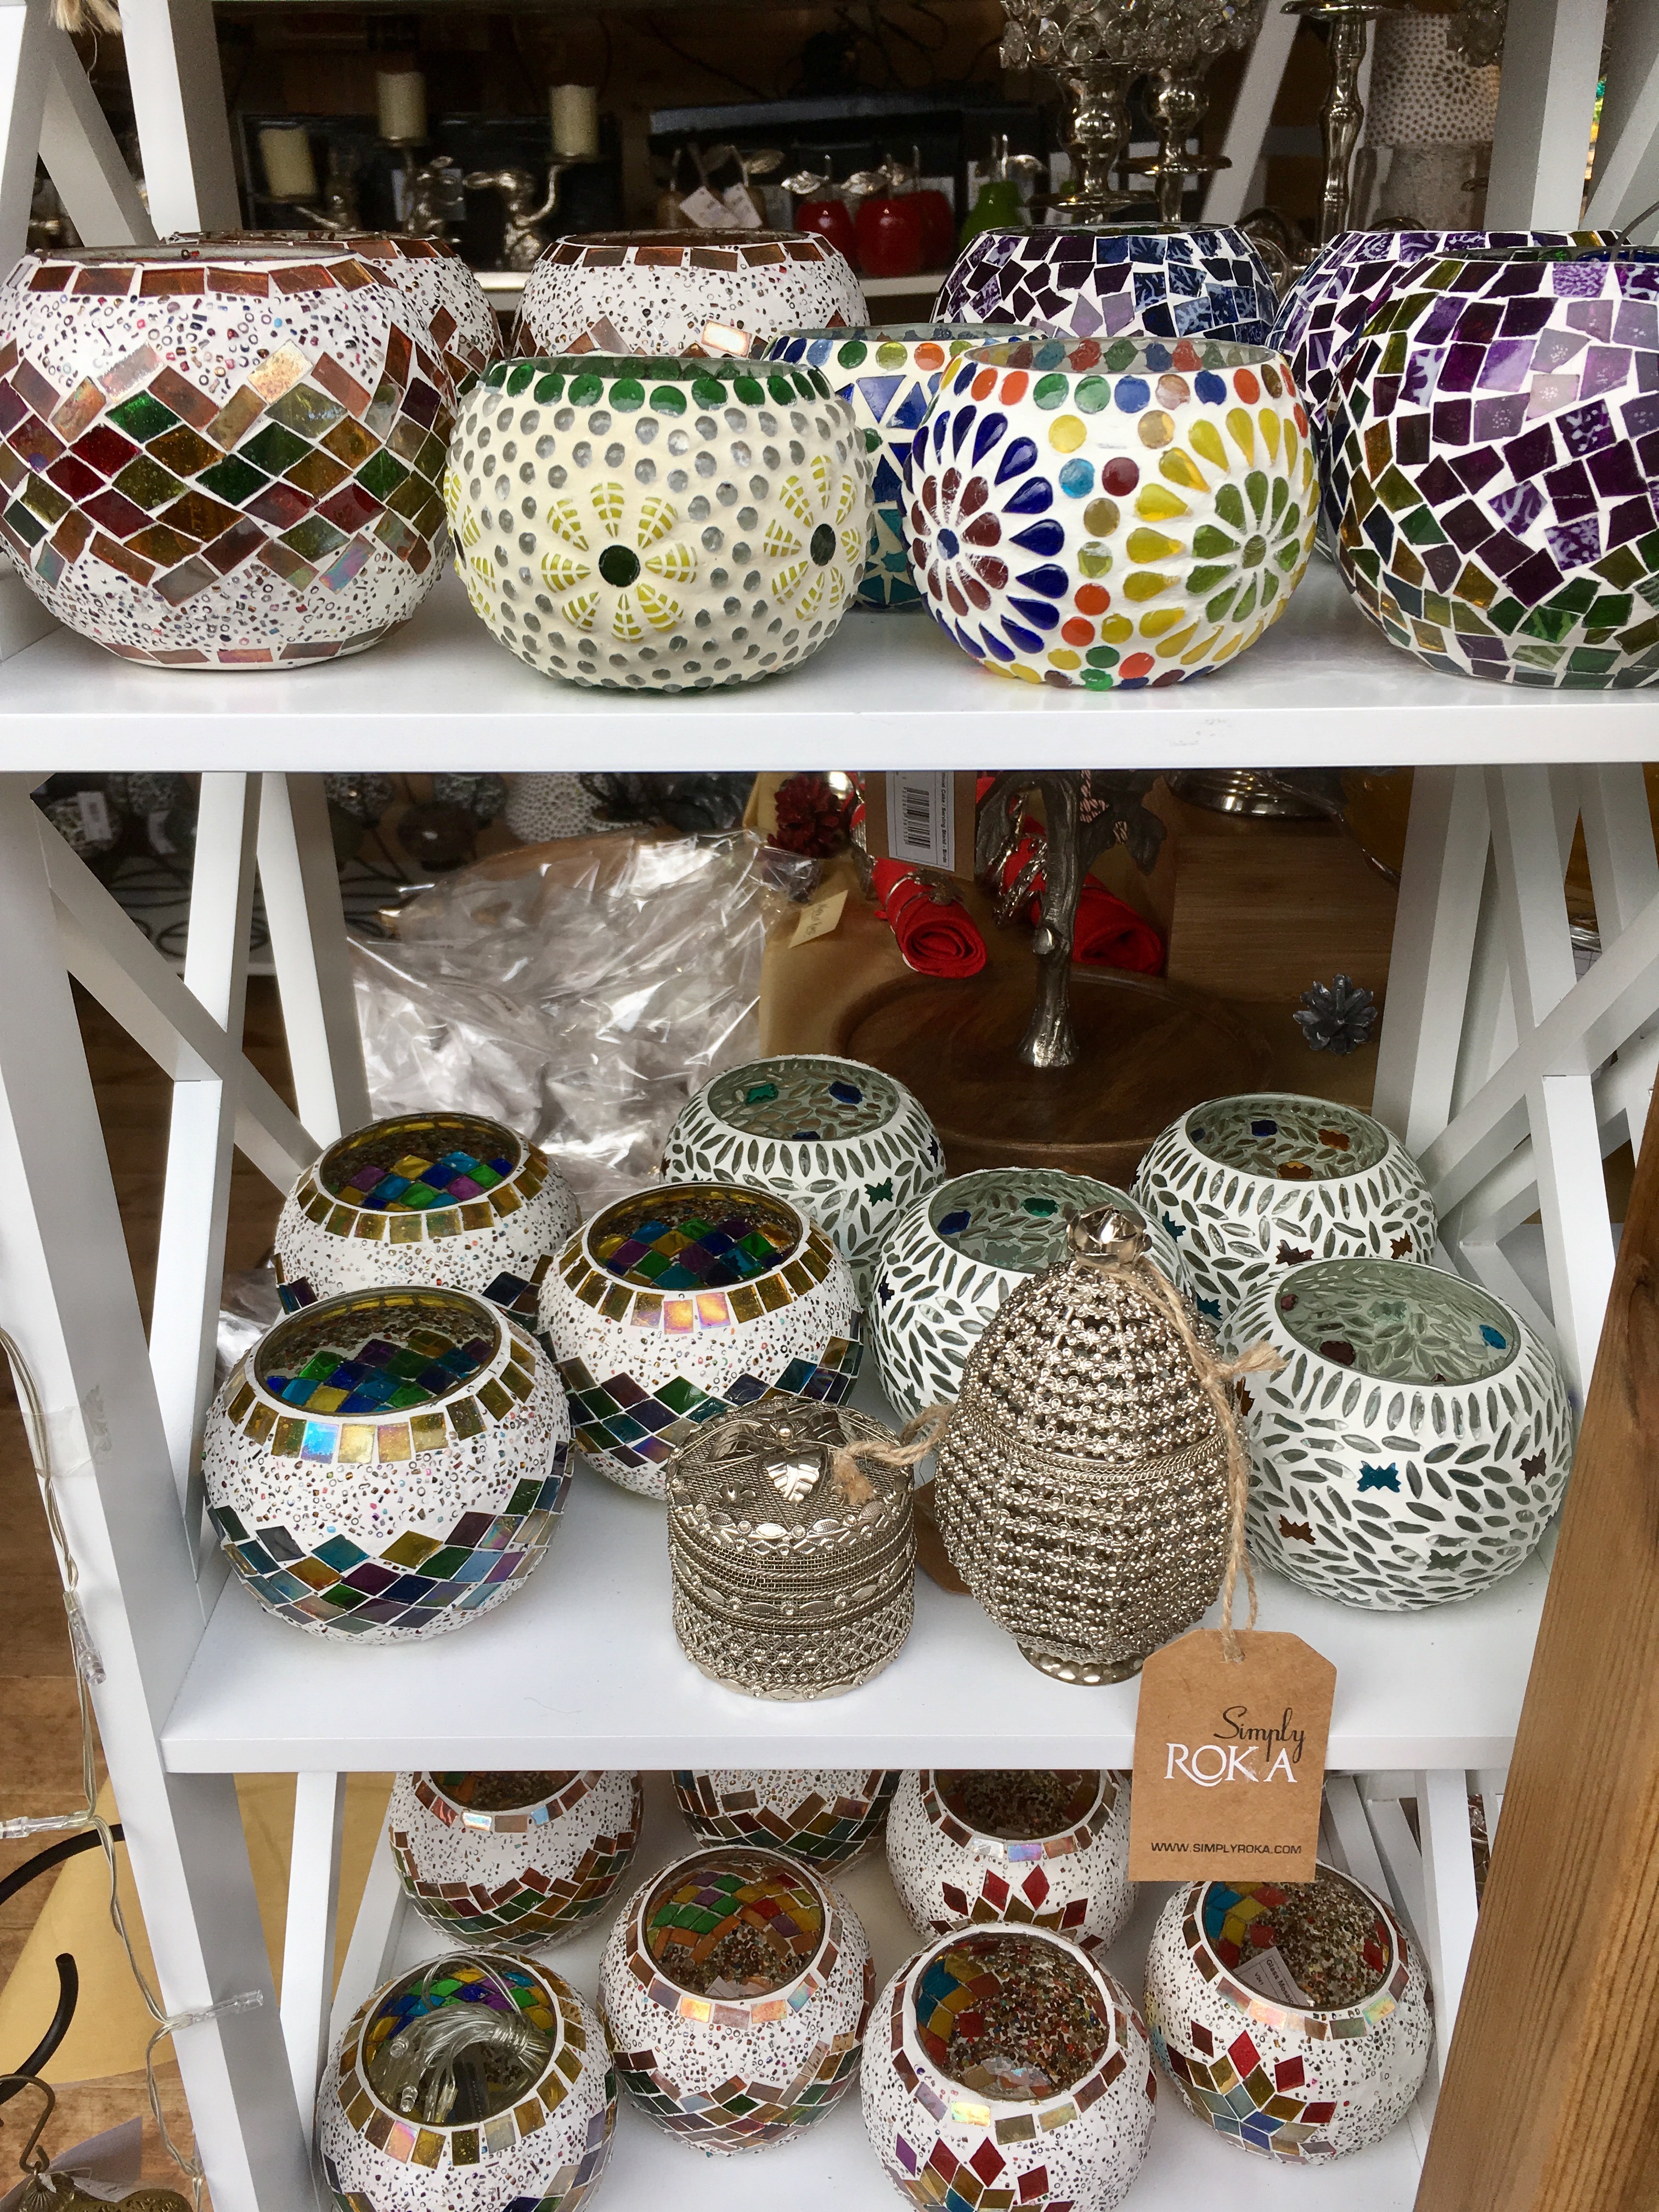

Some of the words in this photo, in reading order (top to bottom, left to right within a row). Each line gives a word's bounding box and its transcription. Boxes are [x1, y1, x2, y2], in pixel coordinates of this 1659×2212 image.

[1213, 1706, 1306, 1763] Simply
[1164, 1742, 1297, 1787] ROKA
[1151, 1842, 1302, 1854] WWW.SIMPLYROKA.COM
[1266, 1959, 1279, 1980] Glass
[1278, 1979, 1294, 2005] Mosaic
